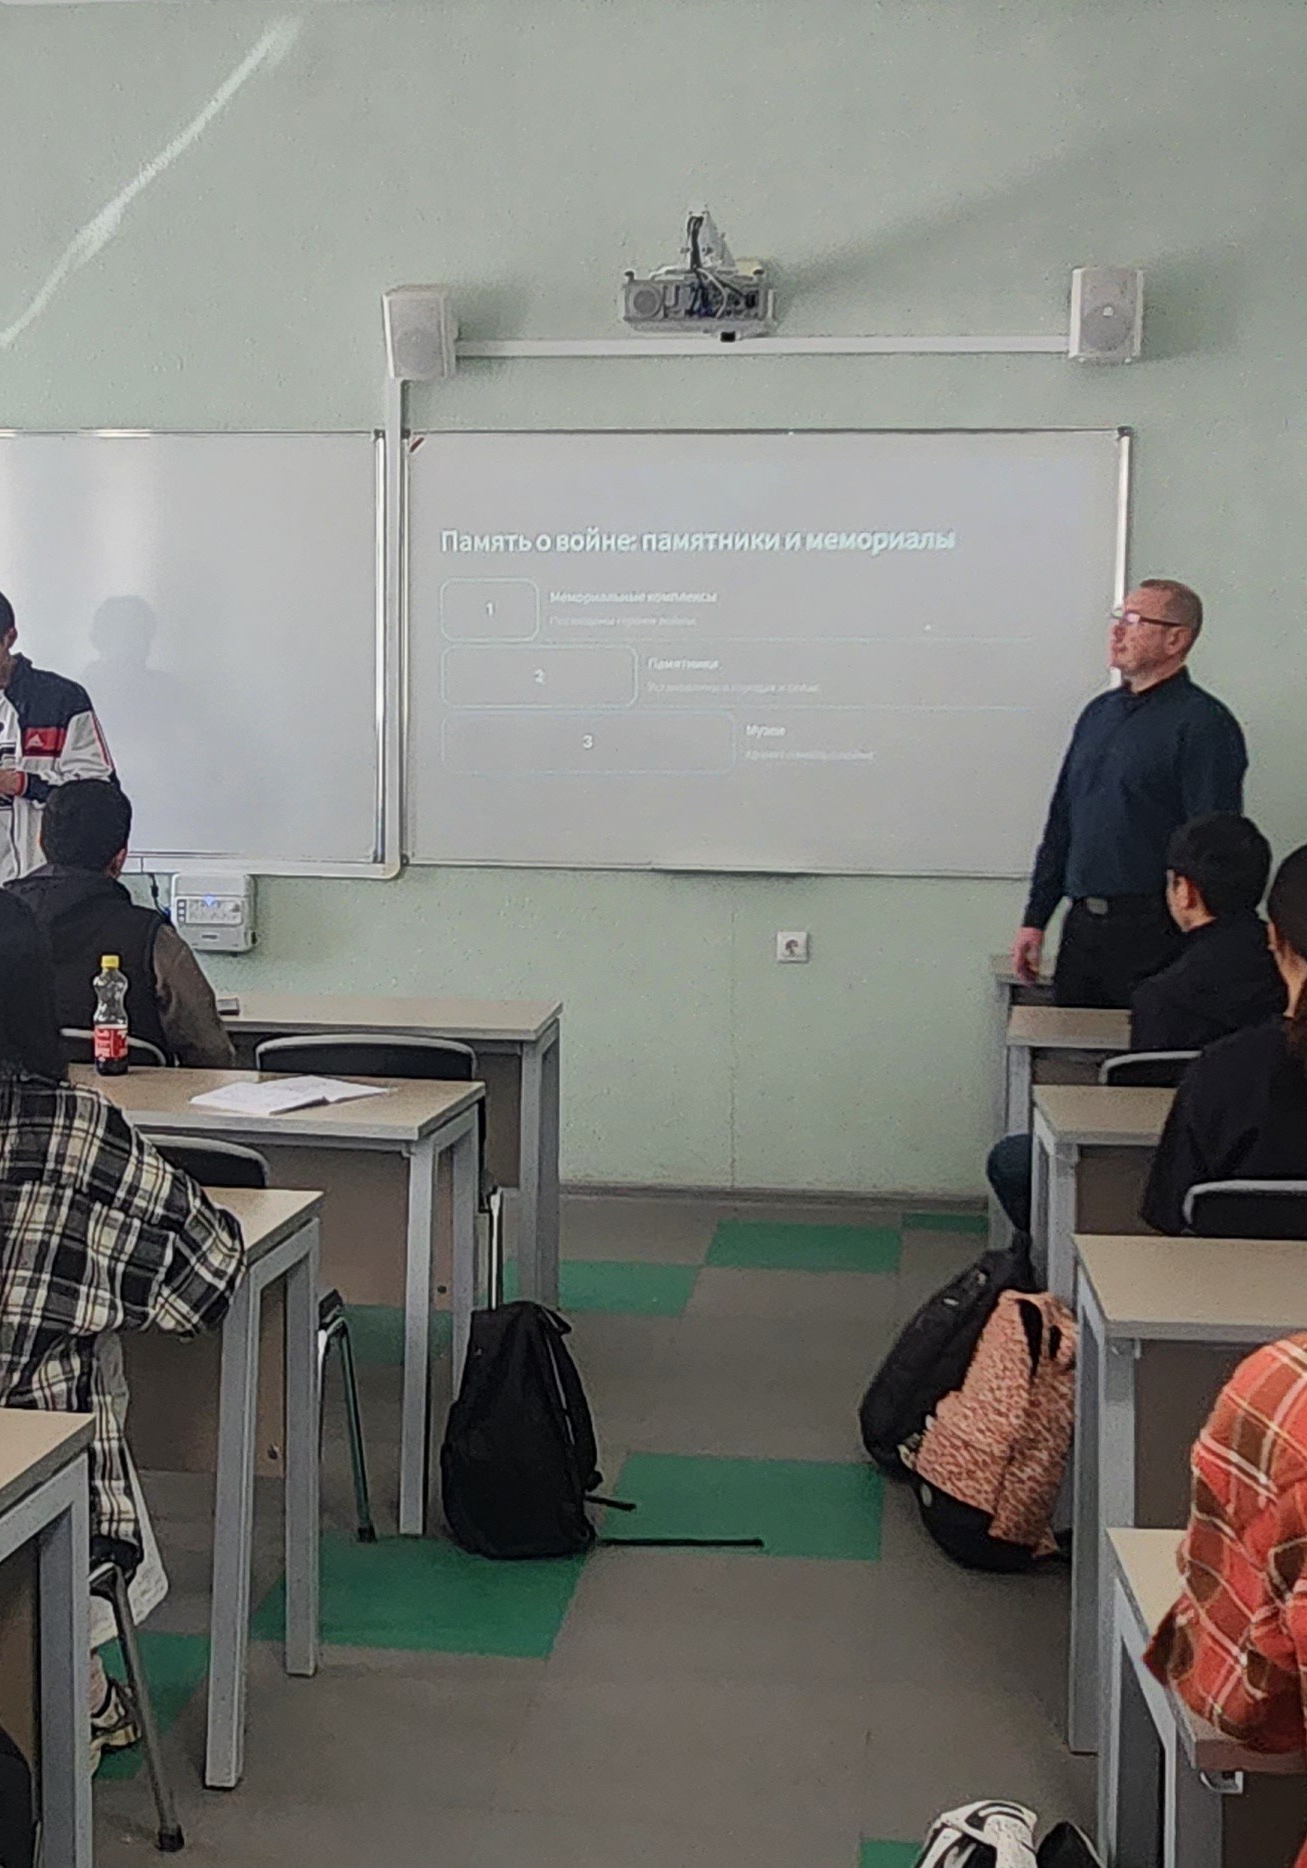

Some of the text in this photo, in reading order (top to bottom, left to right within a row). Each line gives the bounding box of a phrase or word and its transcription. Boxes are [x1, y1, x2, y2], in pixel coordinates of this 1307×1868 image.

[441, 527, 956, 556] Память о войне: памятники и мемориалы
[485, 602, 494, 616] 1
[534, 668, 545, 684] 2
[582, 734, 593, 749] 3
